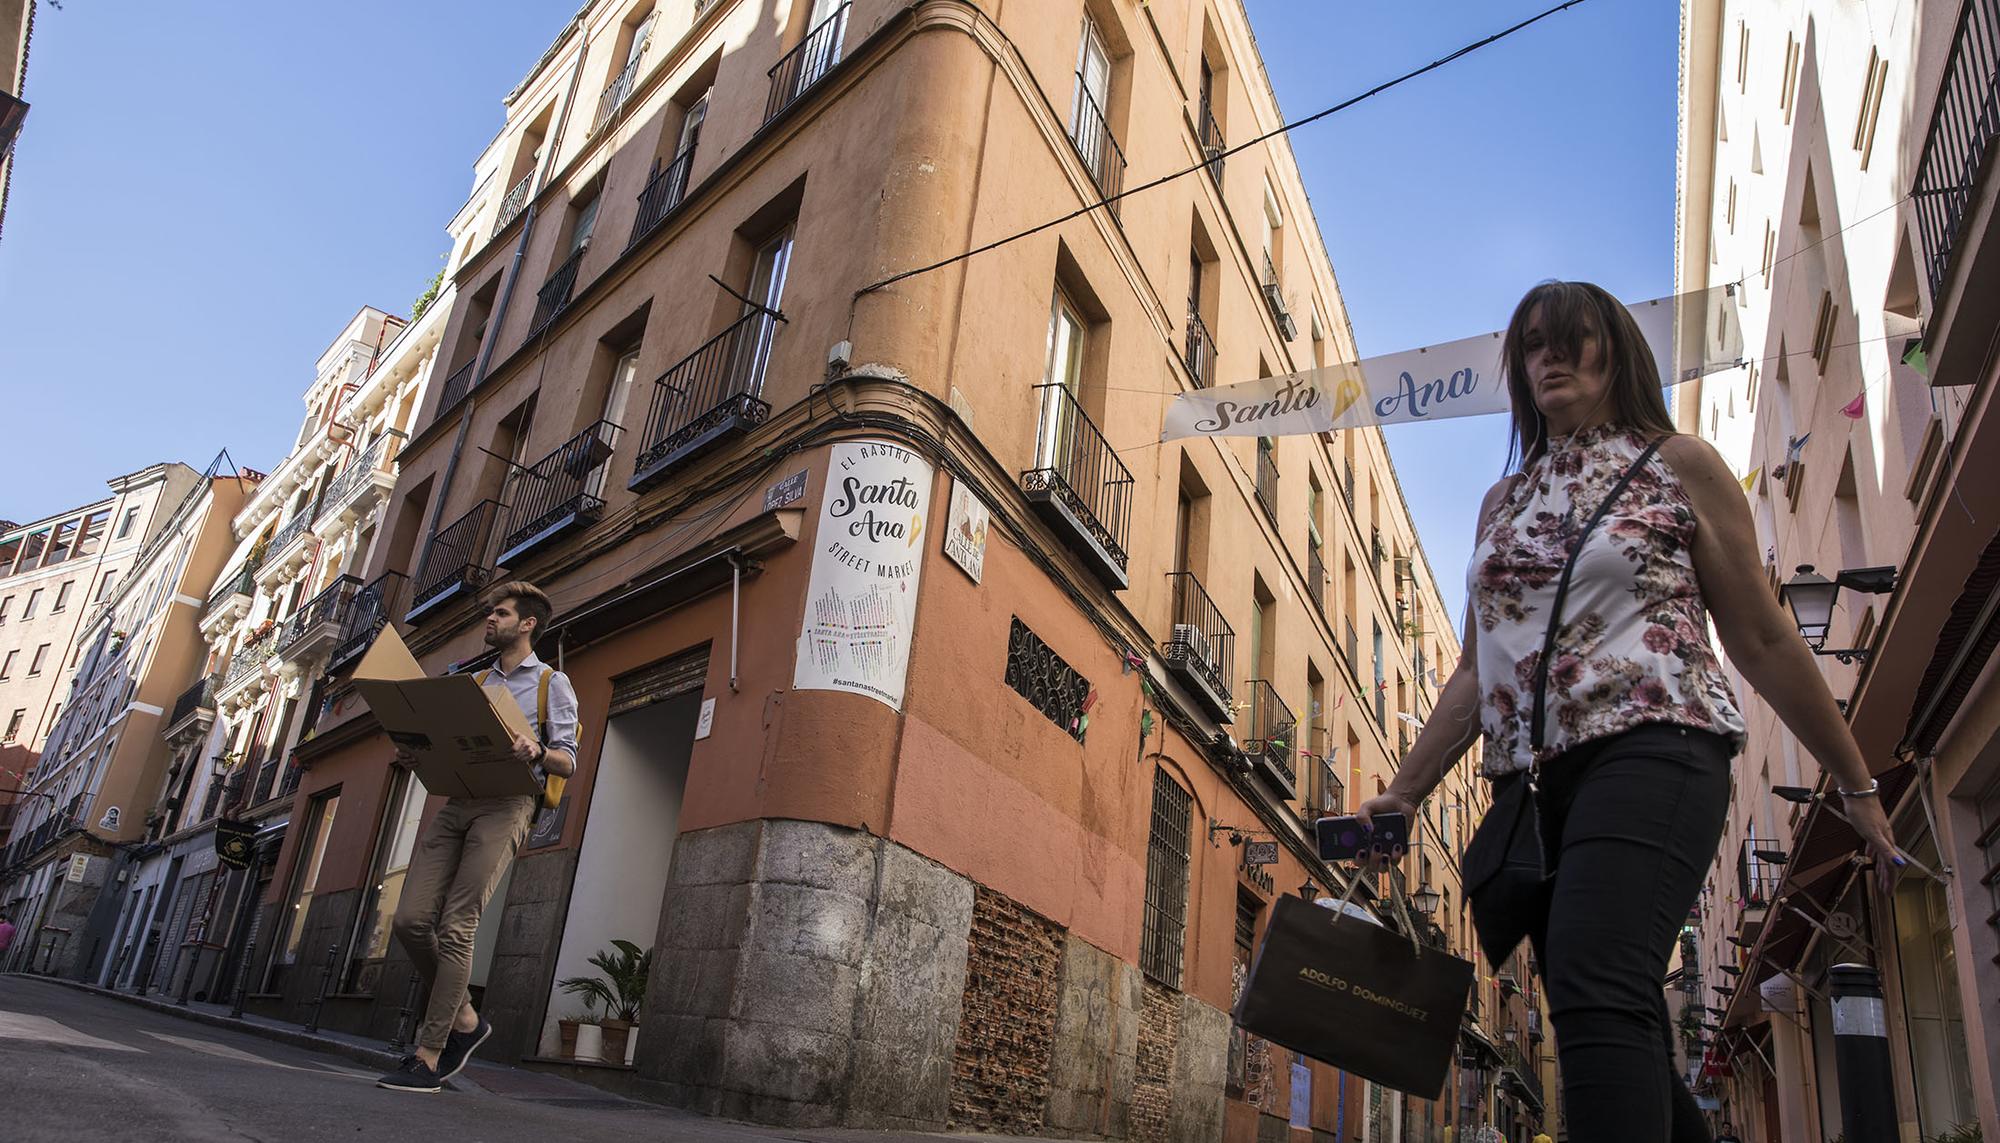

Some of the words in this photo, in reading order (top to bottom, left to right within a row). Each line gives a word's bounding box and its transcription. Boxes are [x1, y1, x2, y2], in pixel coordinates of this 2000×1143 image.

[1194, 378, 1321, 433] Santa
[1374, 367, 1479, 417] Ana
[840, 456, 856, 471] EL
[861, 444, 911, 464] RASTRO
[830, 476, 919, 518] Santa
[849, 510, 906, 543] Ana
[953, 528, 973, 555] CALLE
[828, 542, 871, 573] STREET
[877, 560, 914, 580] MARKET
[967, 559, 981, 581] ANA
[832, 678, 898, 704] #santanastreetmarket
[1300, 967, 1348, 990] ADOLFO
